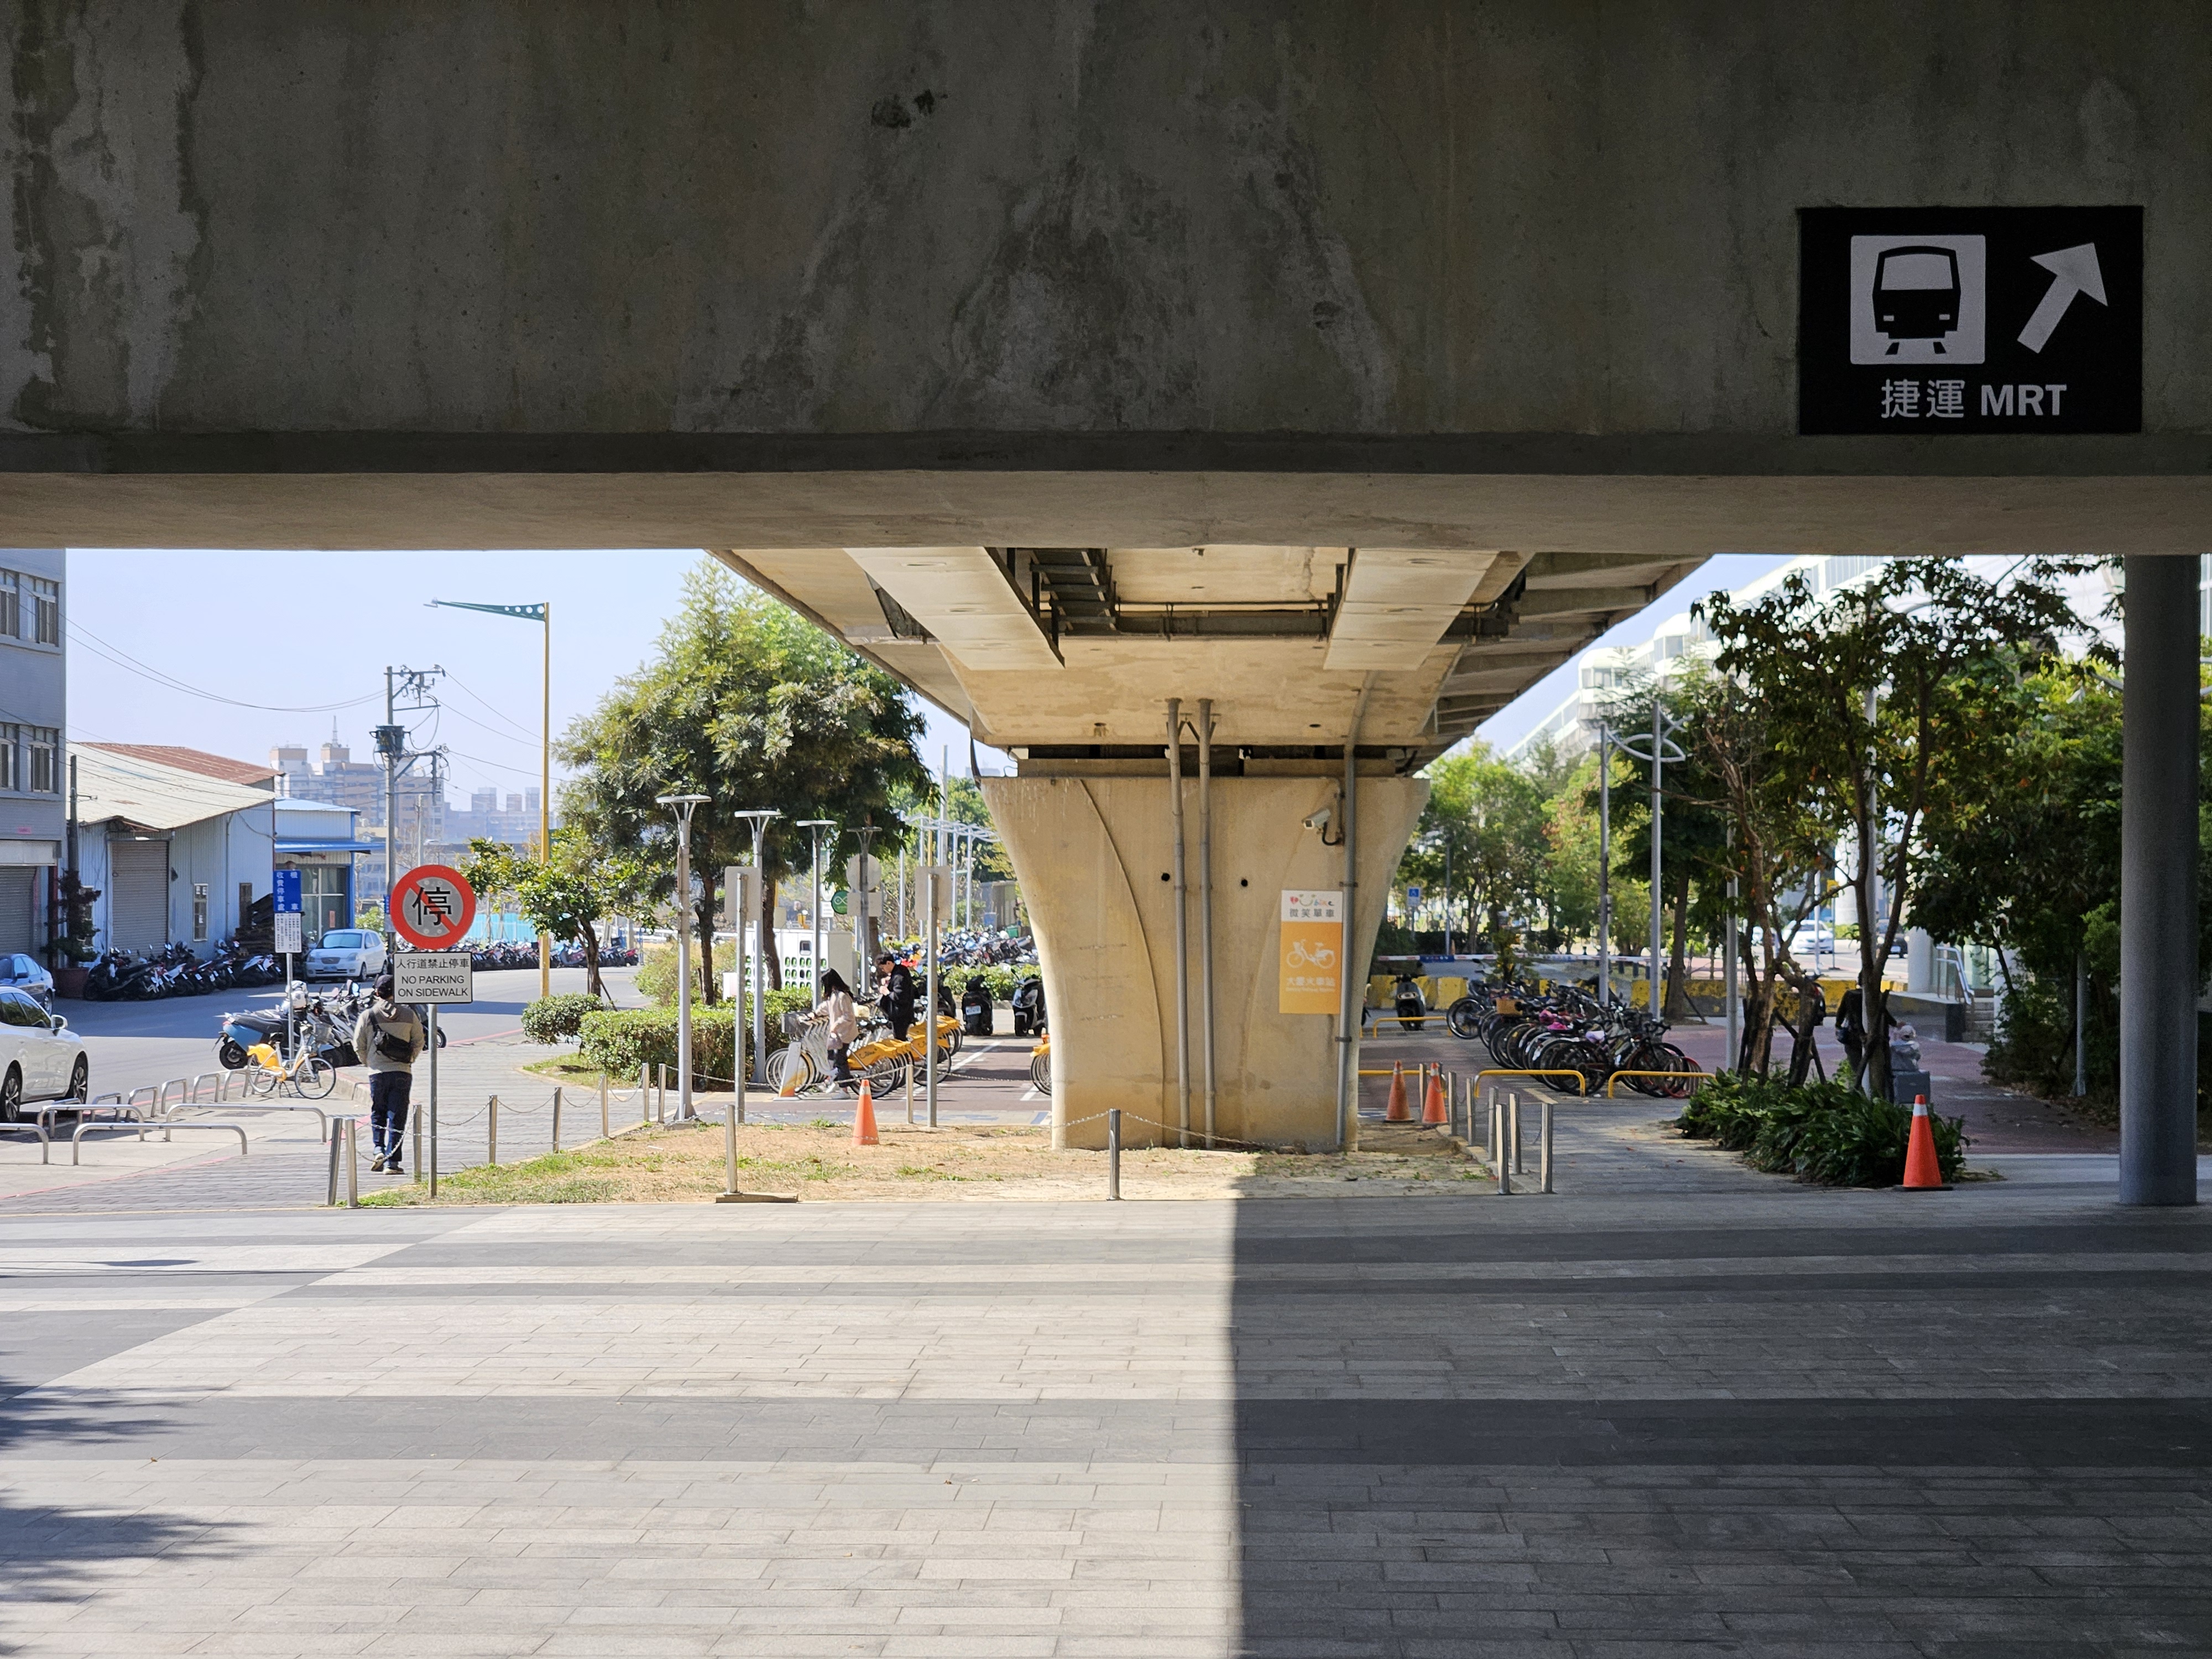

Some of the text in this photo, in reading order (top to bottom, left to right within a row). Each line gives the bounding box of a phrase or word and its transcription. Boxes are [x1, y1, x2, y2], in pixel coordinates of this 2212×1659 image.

[1881, 379, 2067, 418] 捷運 MRT
[412, 886, 452, 926] 停
[1290, 909, 1334, 917] 微笑單車
[397, 958, 469, 968] 人行道禁止停車
[401, 975, 465, 984] NO PARKING
[398, 988, 468, 997] ON SIDEWALK
